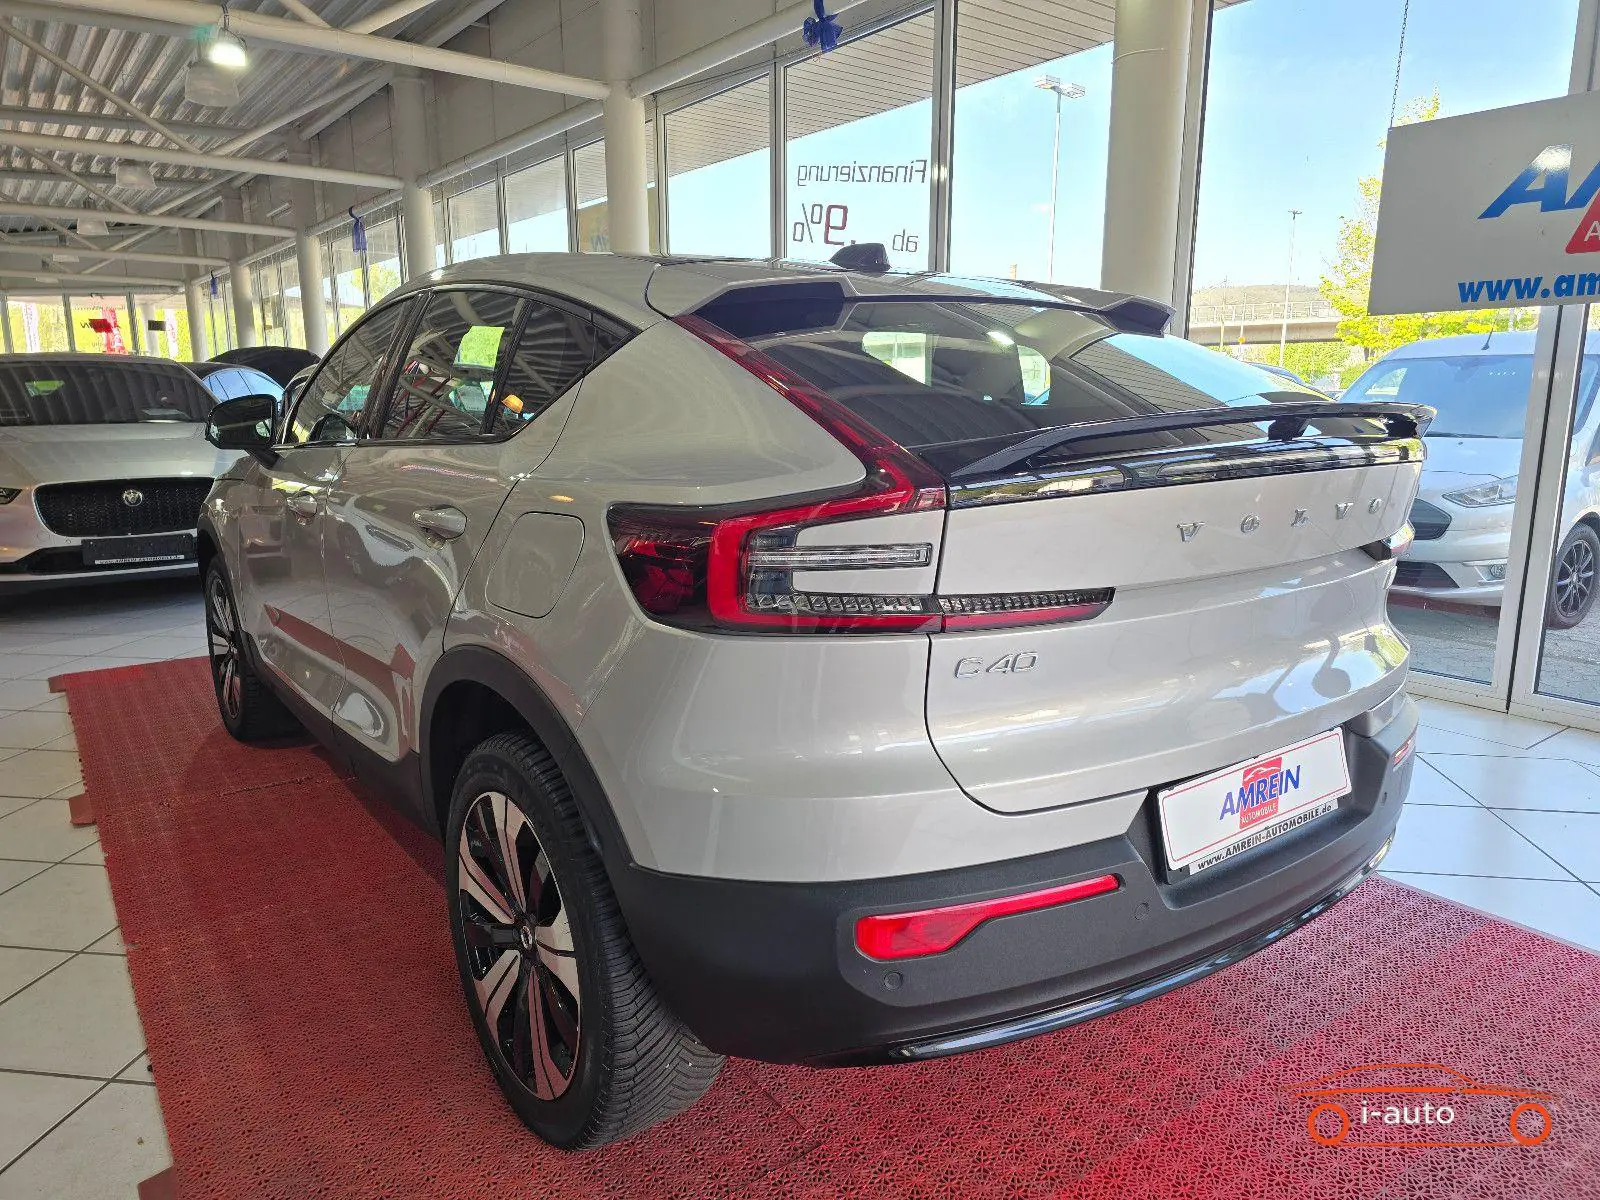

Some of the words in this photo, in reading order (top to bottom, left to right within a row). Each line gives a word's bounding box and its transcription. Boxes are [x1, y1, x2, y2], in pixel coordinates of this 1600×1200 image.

[1177, 498, 1383, 542] VOLVO
[954, 651, 1038, 678] C40
[1219, 765, 1301, 821] AMREIN
[1240, 803, 1278, 825] AUTOMOBILE
